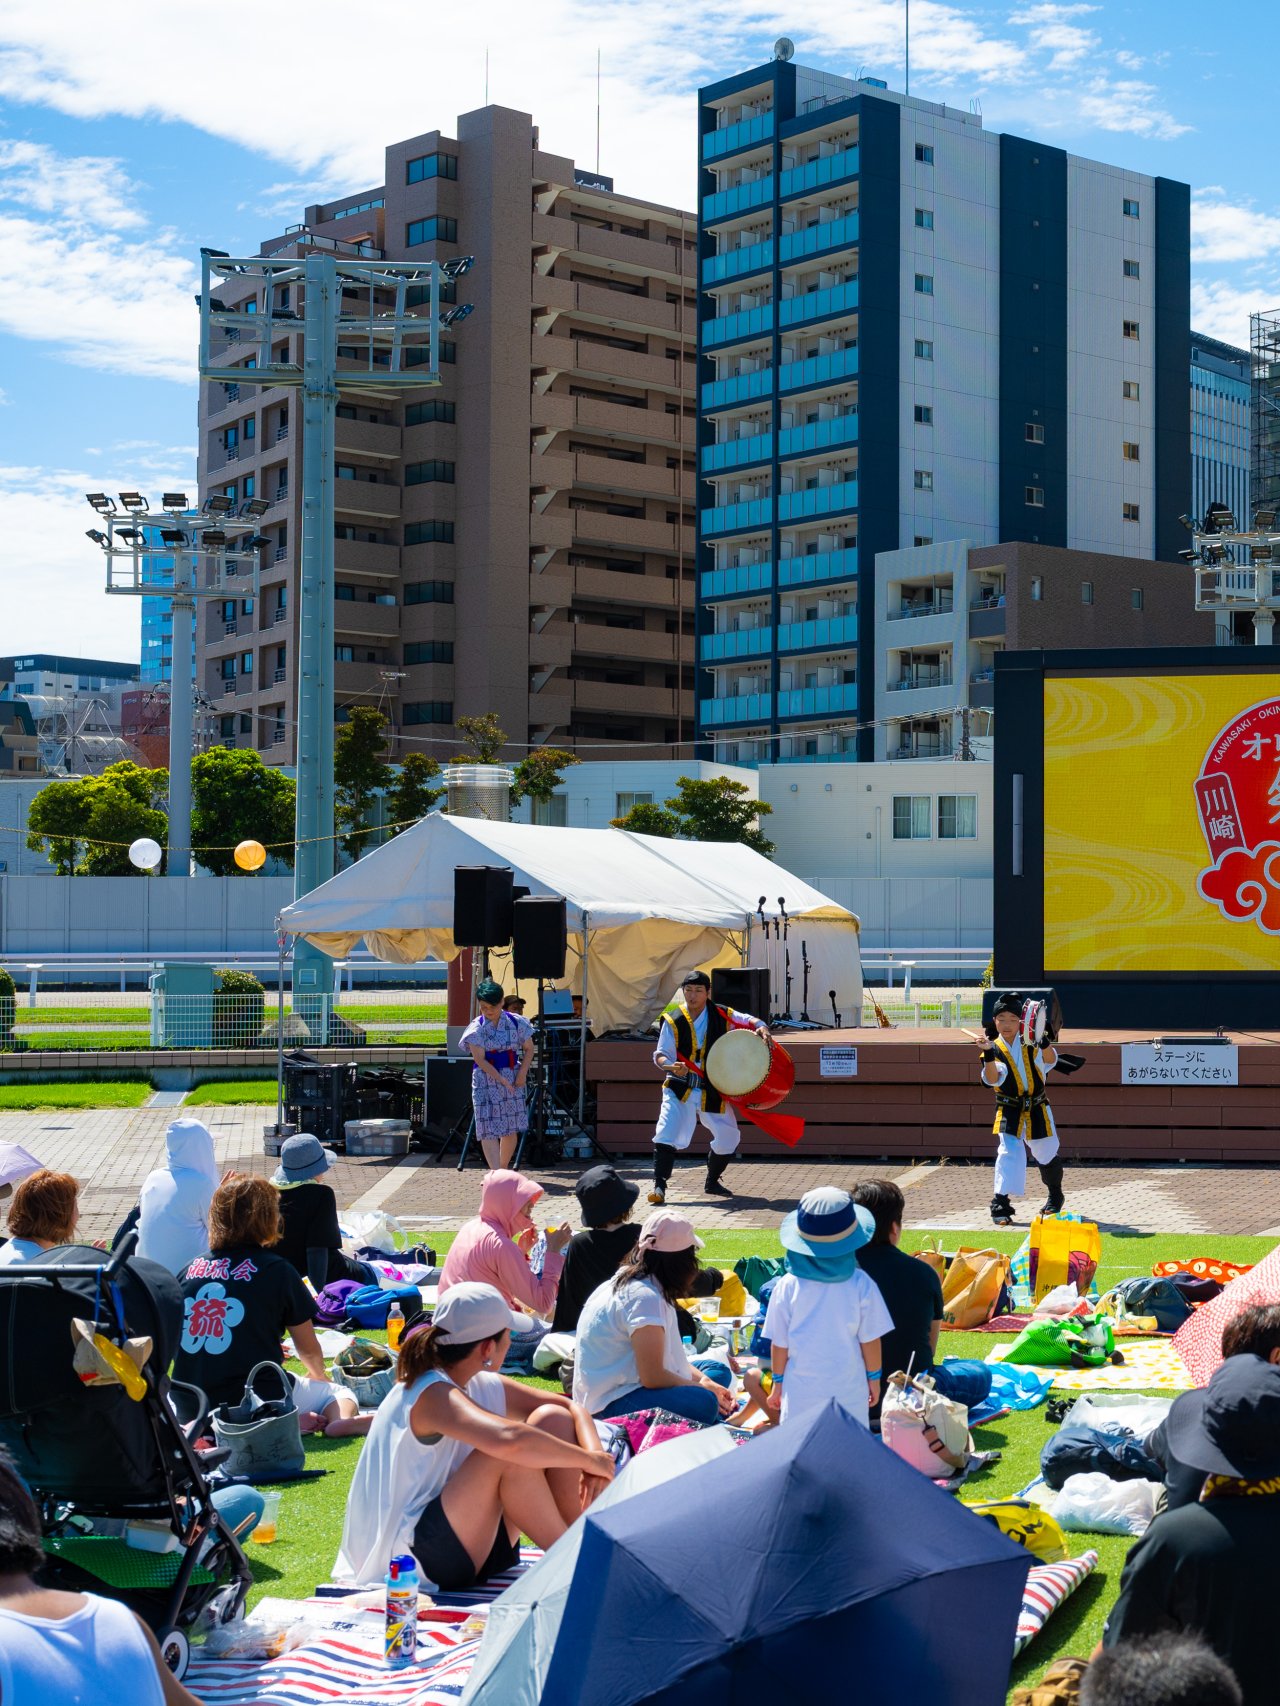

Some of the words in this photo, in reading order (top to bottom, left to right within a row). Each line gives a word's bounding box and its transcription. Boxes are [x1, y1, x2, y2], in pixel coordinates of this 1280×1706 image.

[1212, 719, 1252, 764] KAWASAKI
[1203, 786, 1236, 841] 川崎
[1154, 1051, 1206, 1063] ステージに
[1128, 1067, 1232, 1079] あがらないでください
